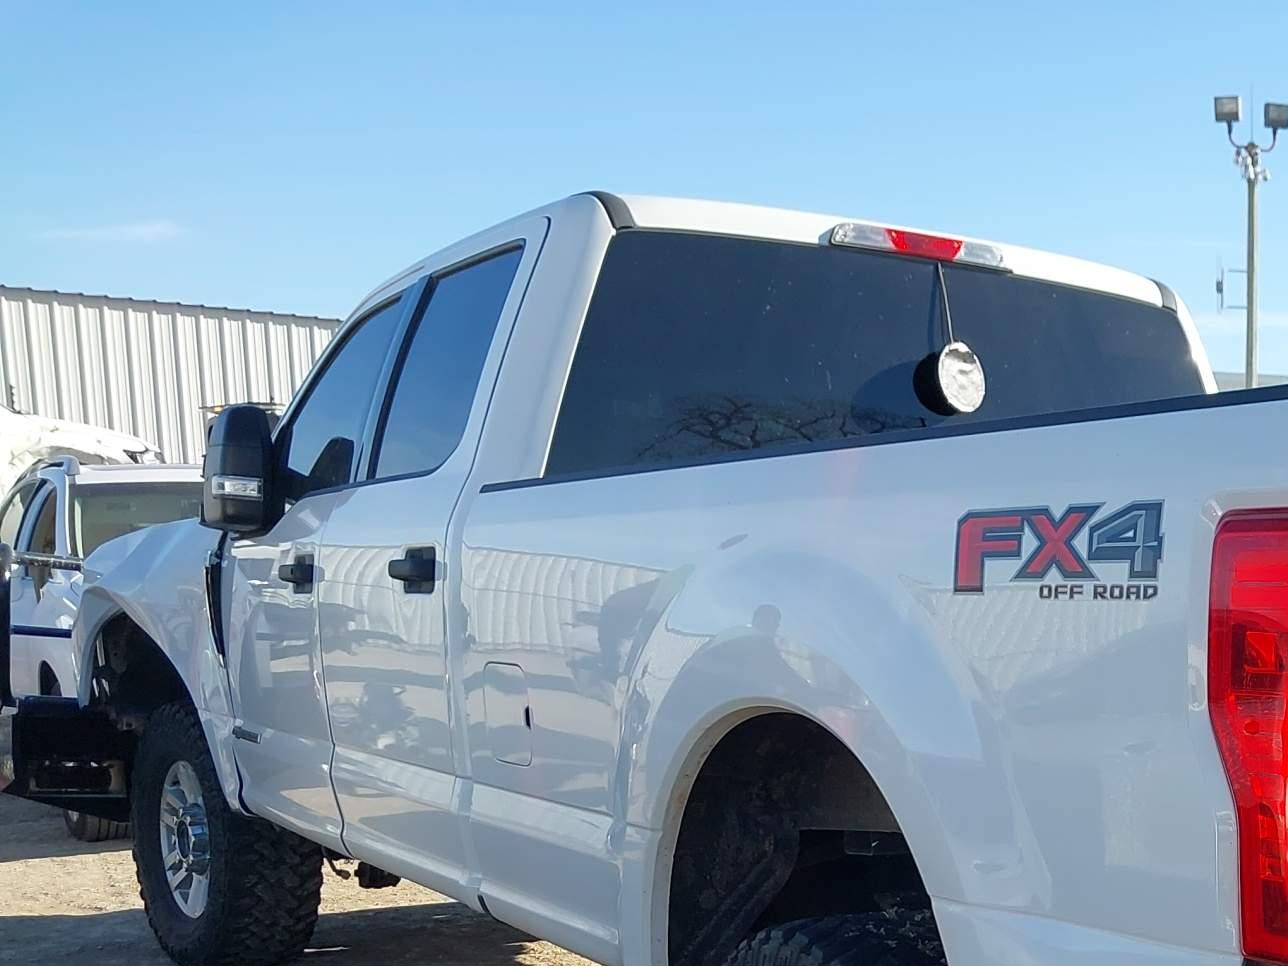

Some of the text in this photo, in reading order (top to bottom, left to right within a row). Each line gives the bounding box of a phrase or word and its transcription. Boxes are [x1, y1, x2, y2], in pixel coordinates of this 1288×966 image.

[954, 499, 1165, 595] FX4
[1039, 584, 1159, 600] OFF ROAD
